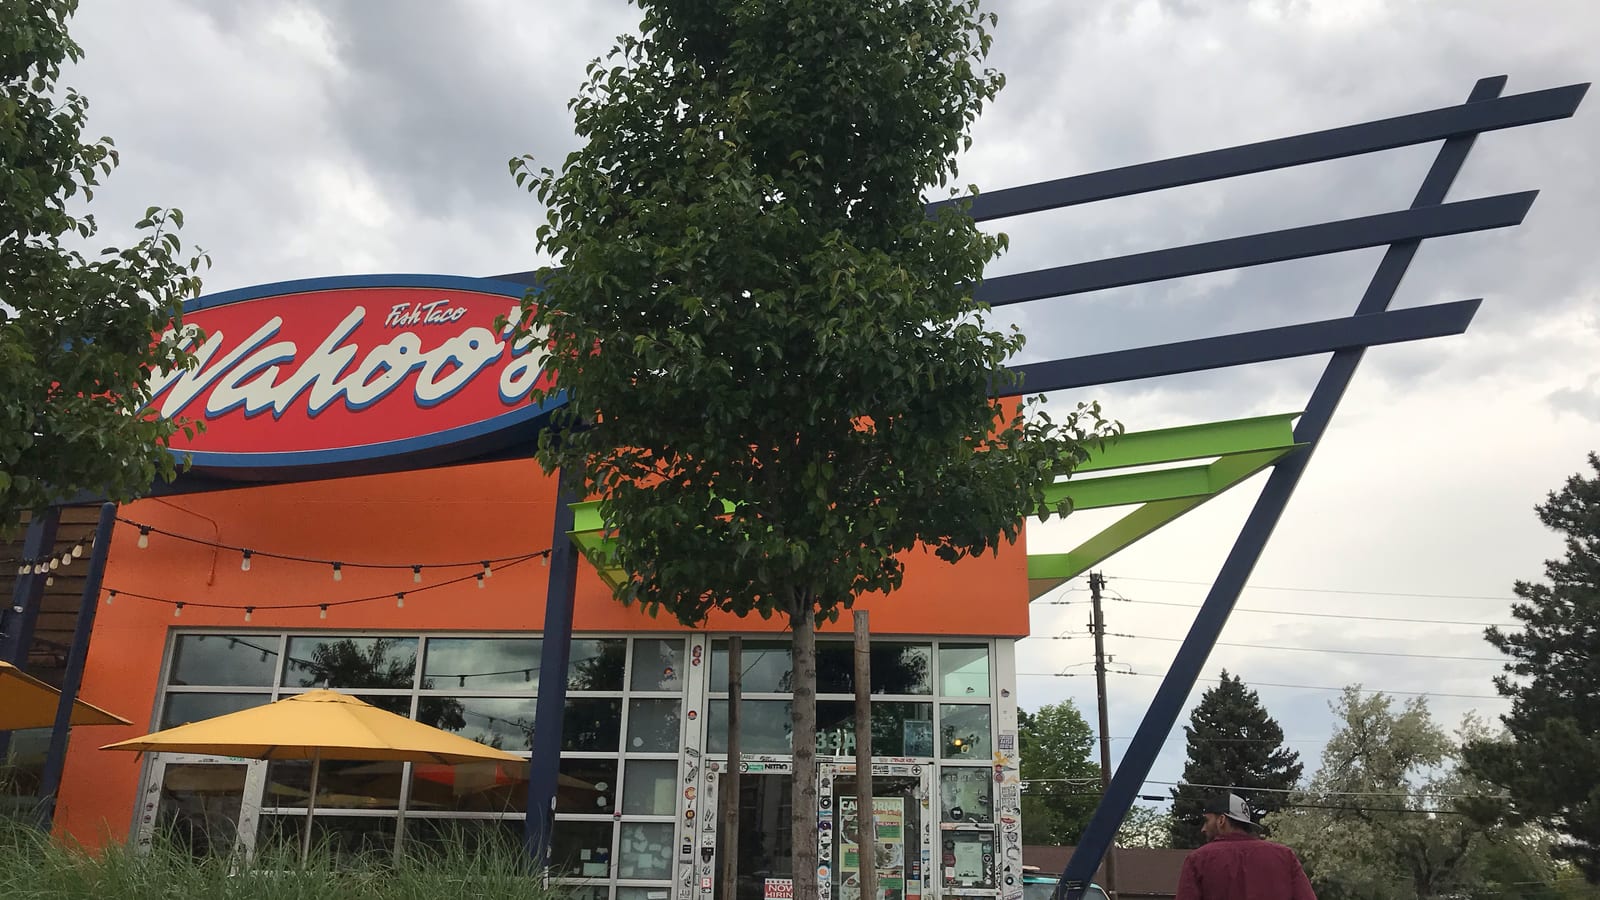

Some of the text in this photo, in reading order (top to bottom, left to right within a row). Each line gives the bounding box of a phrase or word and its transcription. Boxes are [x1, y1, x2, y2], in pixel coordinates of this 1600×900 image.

[385, 299, 467, 326] Fish Taco
[131, 304, 552, 420] Wahoo's
[785, 731, 857, 749] 133A
[842, 800, 903, 811] CAORNIA
